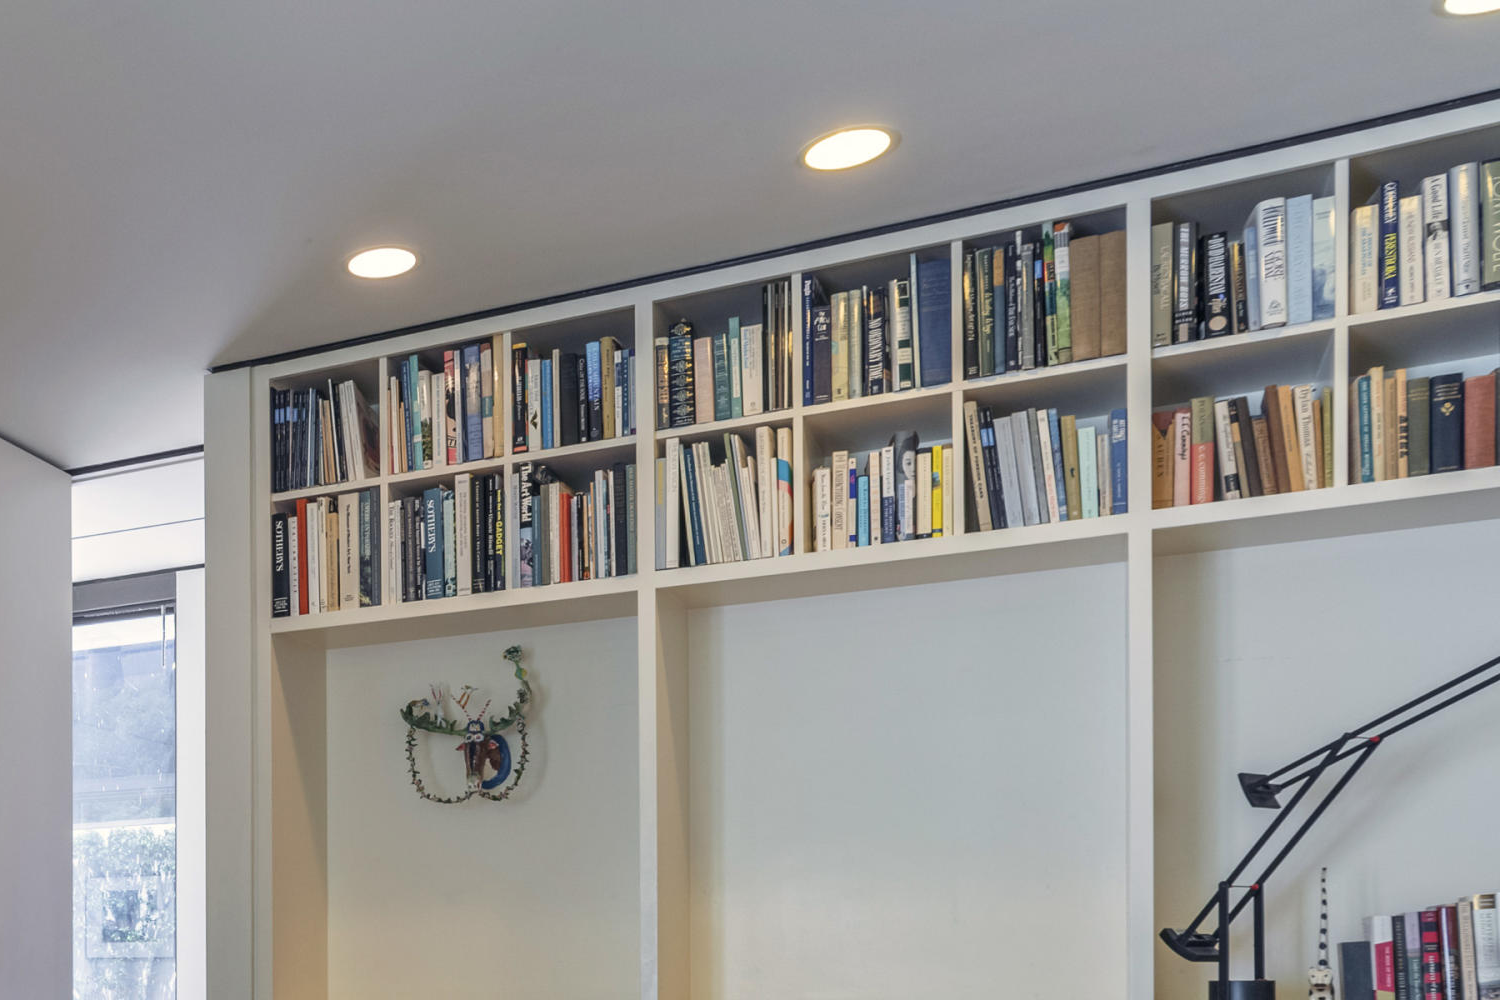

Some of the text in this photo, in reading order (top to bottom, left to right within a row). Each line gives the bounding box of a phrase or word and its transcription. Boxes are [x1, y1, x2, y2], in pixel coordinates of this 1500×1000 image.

[1299, 389, 1312, 446] Dylan Thomas
[520, 463, 532, 522] The Art World
[275, 520, 284, 571] SOTHEBY'S
[427, 500, 436, 553] SOTHEBY'S
